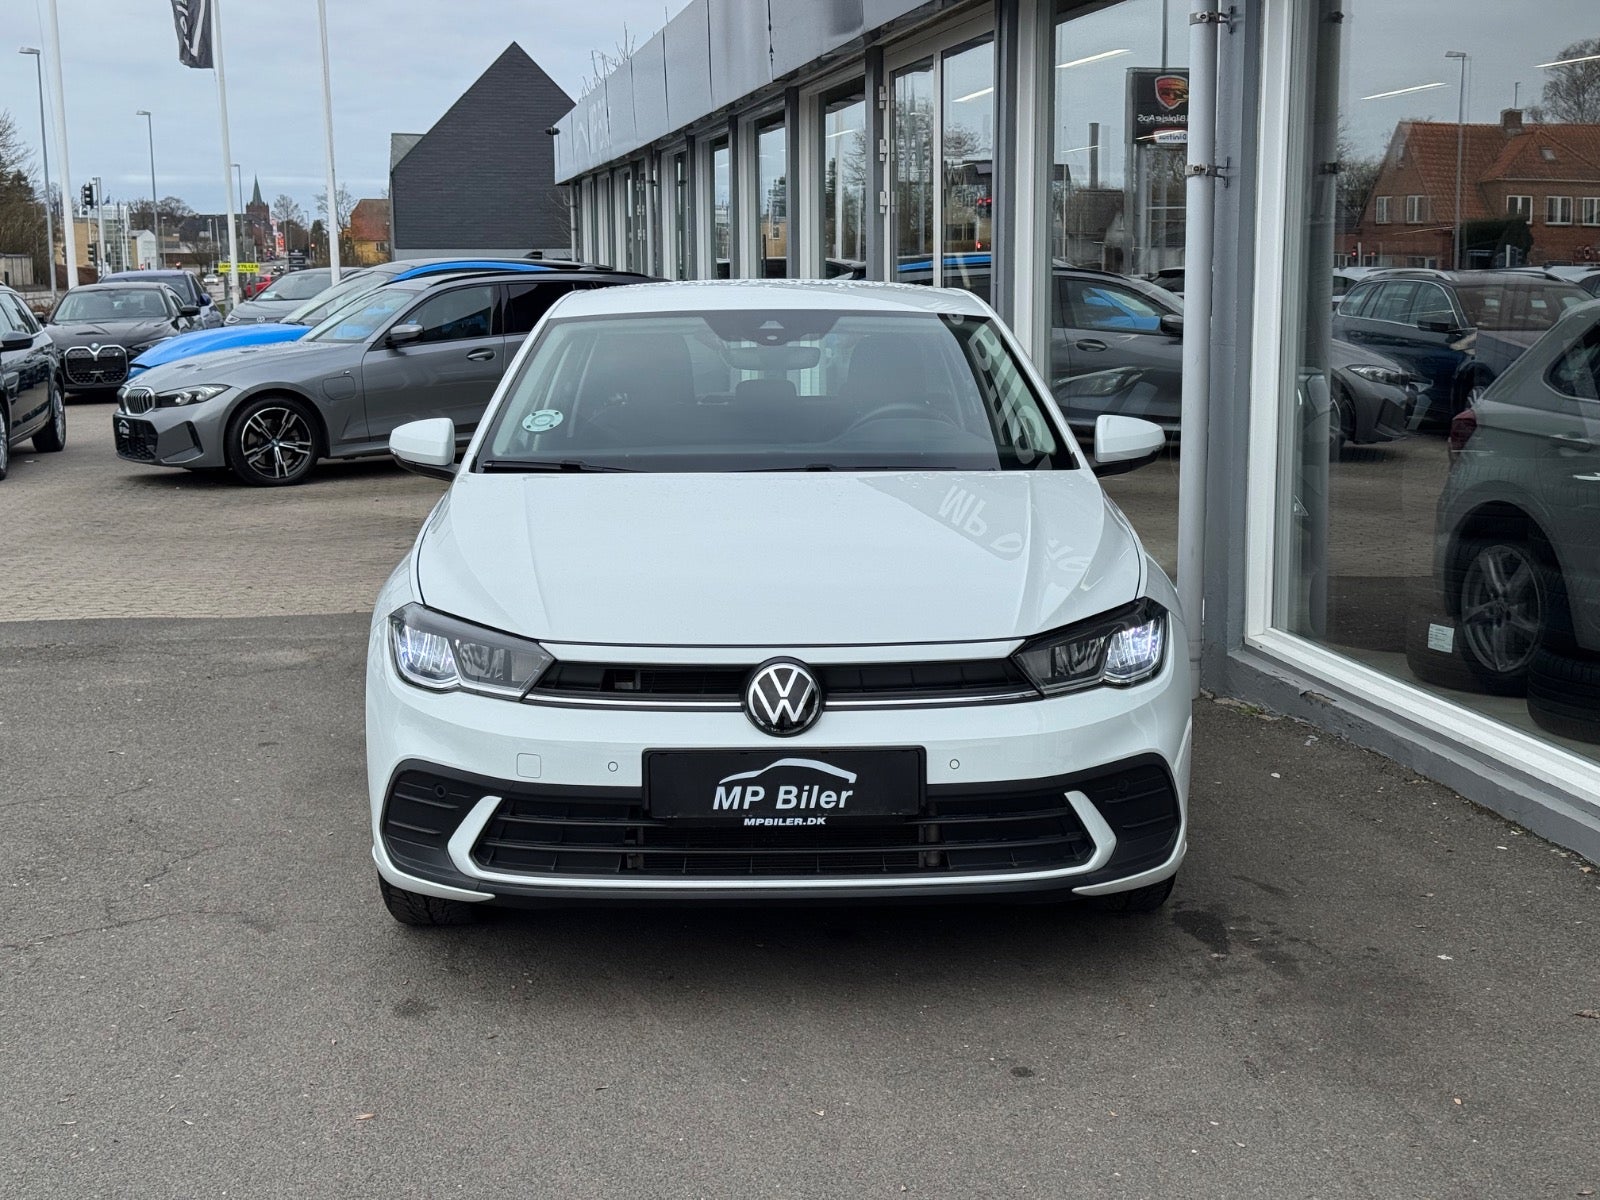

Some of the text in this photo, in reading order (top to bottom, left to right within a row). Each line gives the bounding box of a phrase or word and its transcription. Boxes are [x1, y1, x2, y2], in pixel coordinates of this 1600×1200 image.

[713, 784, 854, 811] MP Biler
[743, 816, 827, 827] MPBILER.DK
